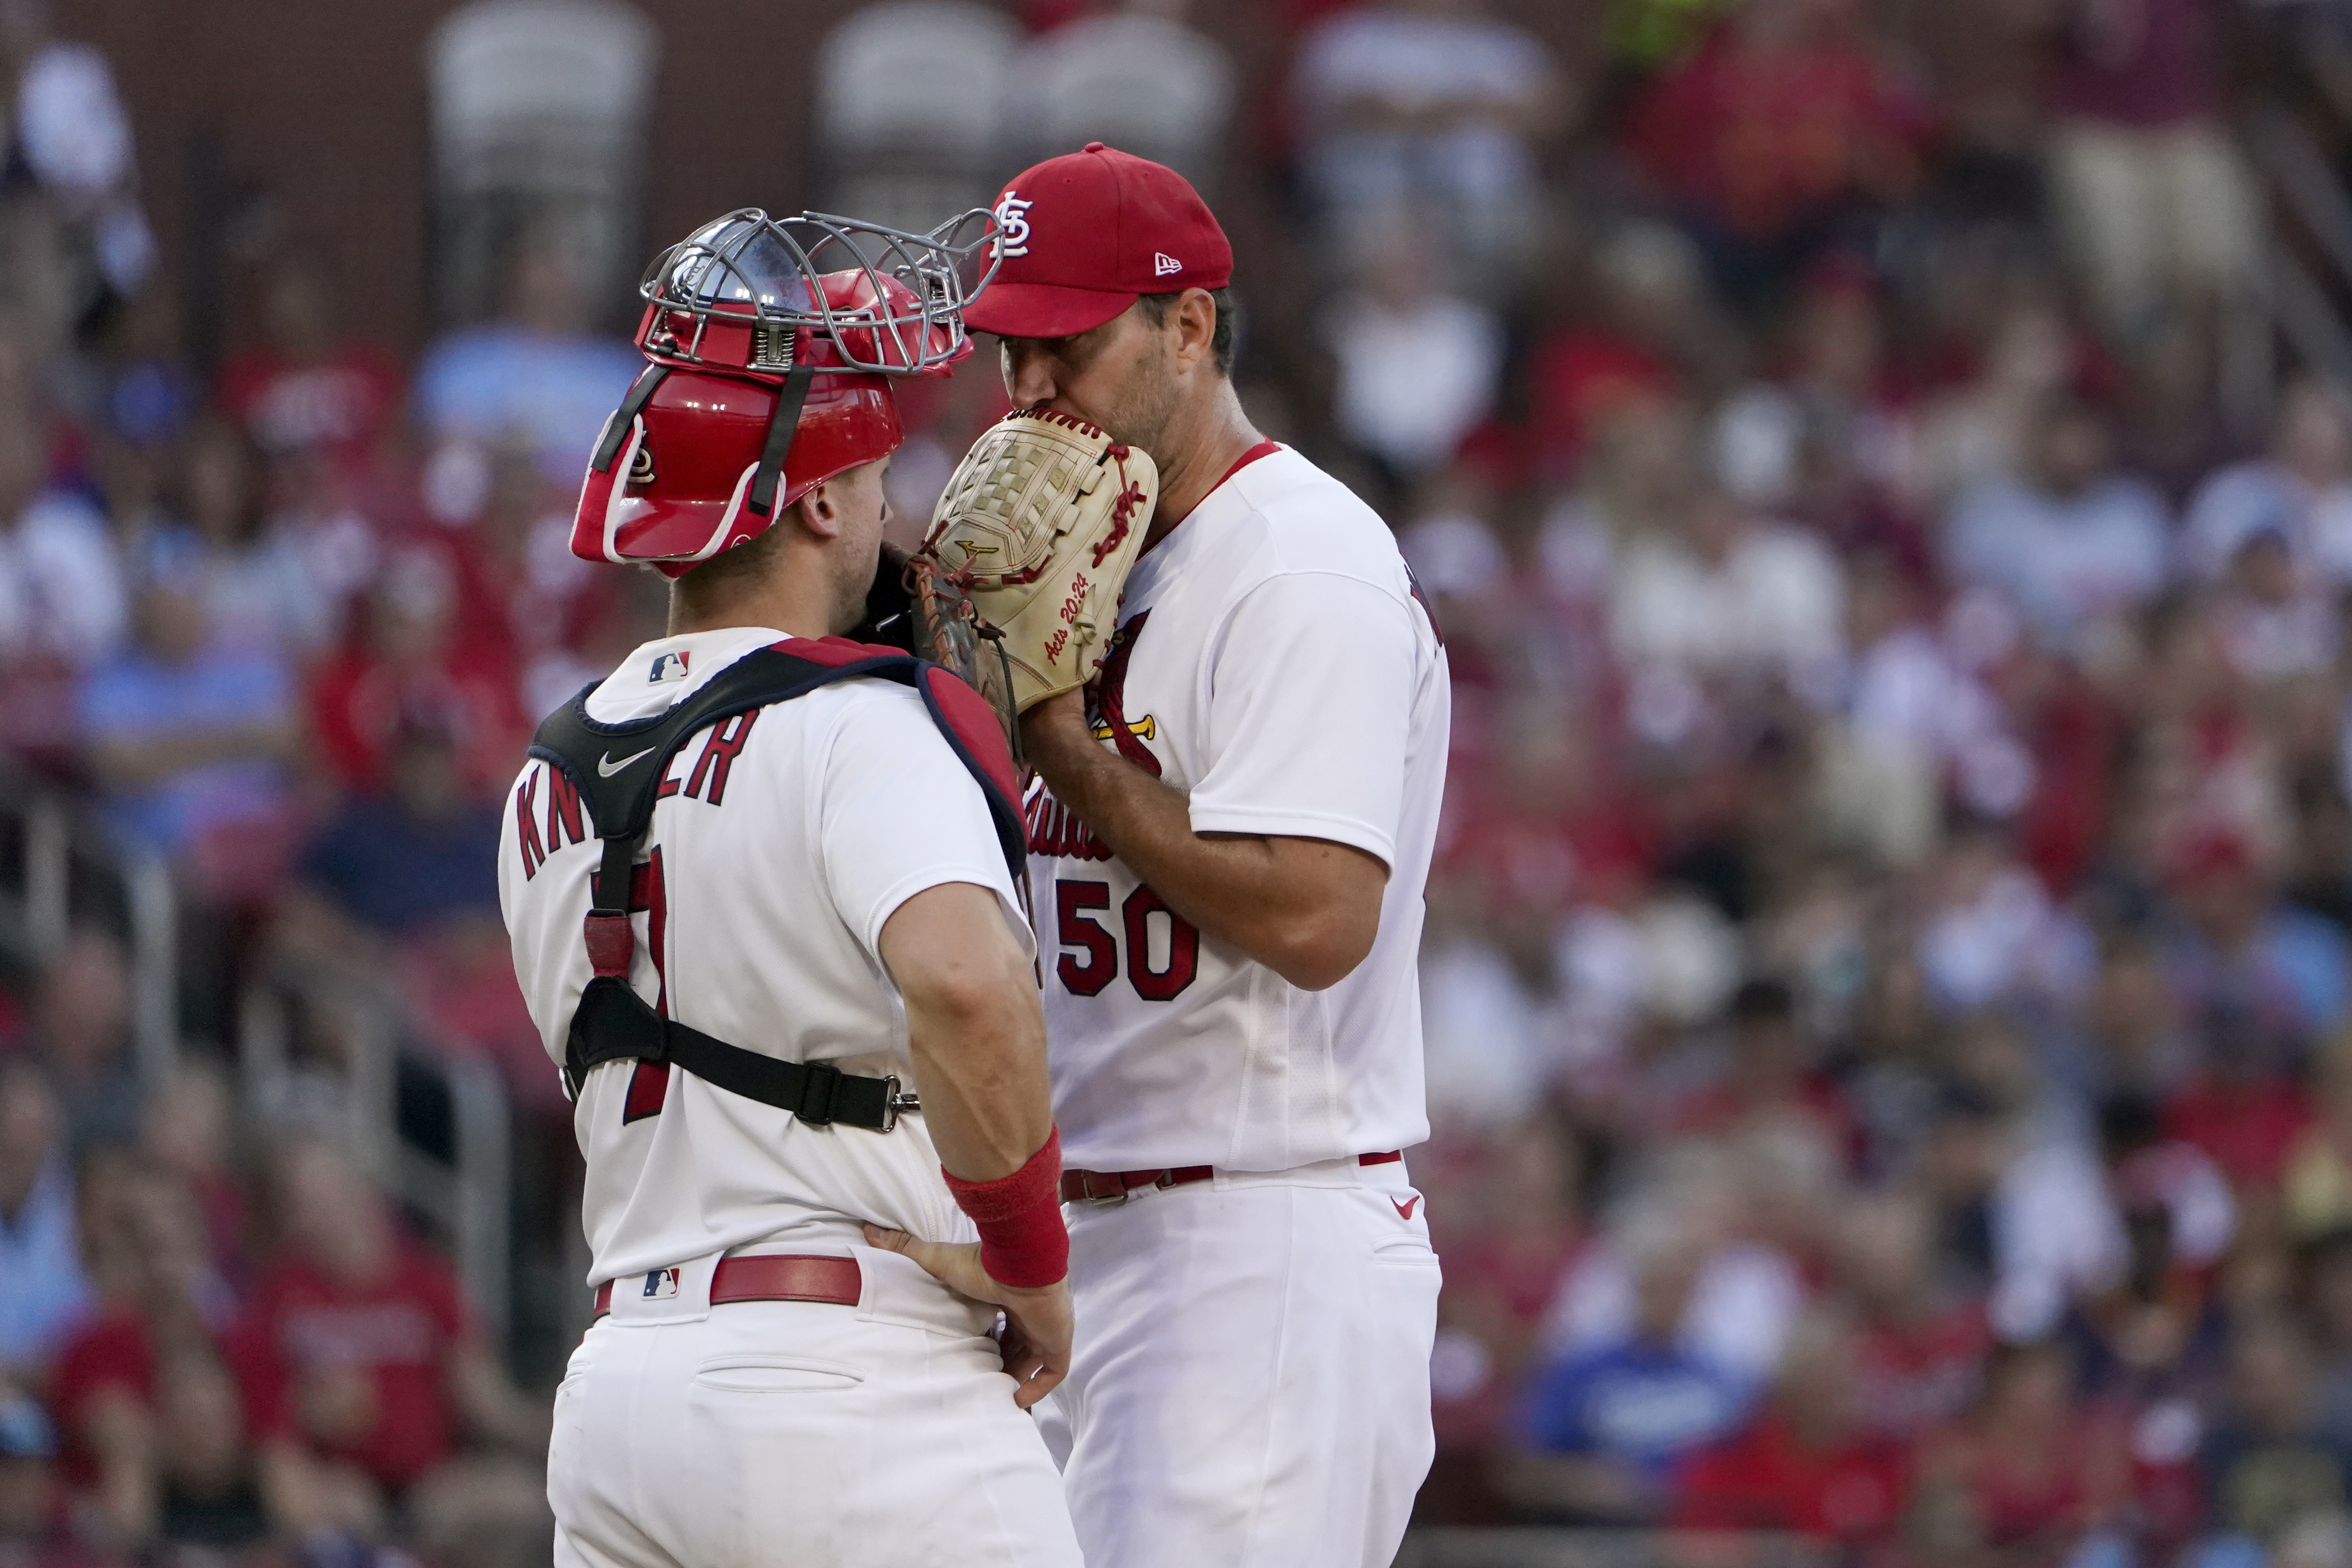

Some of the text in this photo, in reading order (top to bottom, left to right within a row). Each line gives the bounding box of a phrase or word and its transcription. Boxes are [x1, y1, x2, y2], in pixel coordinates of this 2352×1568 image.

[1044, 572, 1089, 666] Acts 20:24
[1056, 879, 1199, 1001] 50
